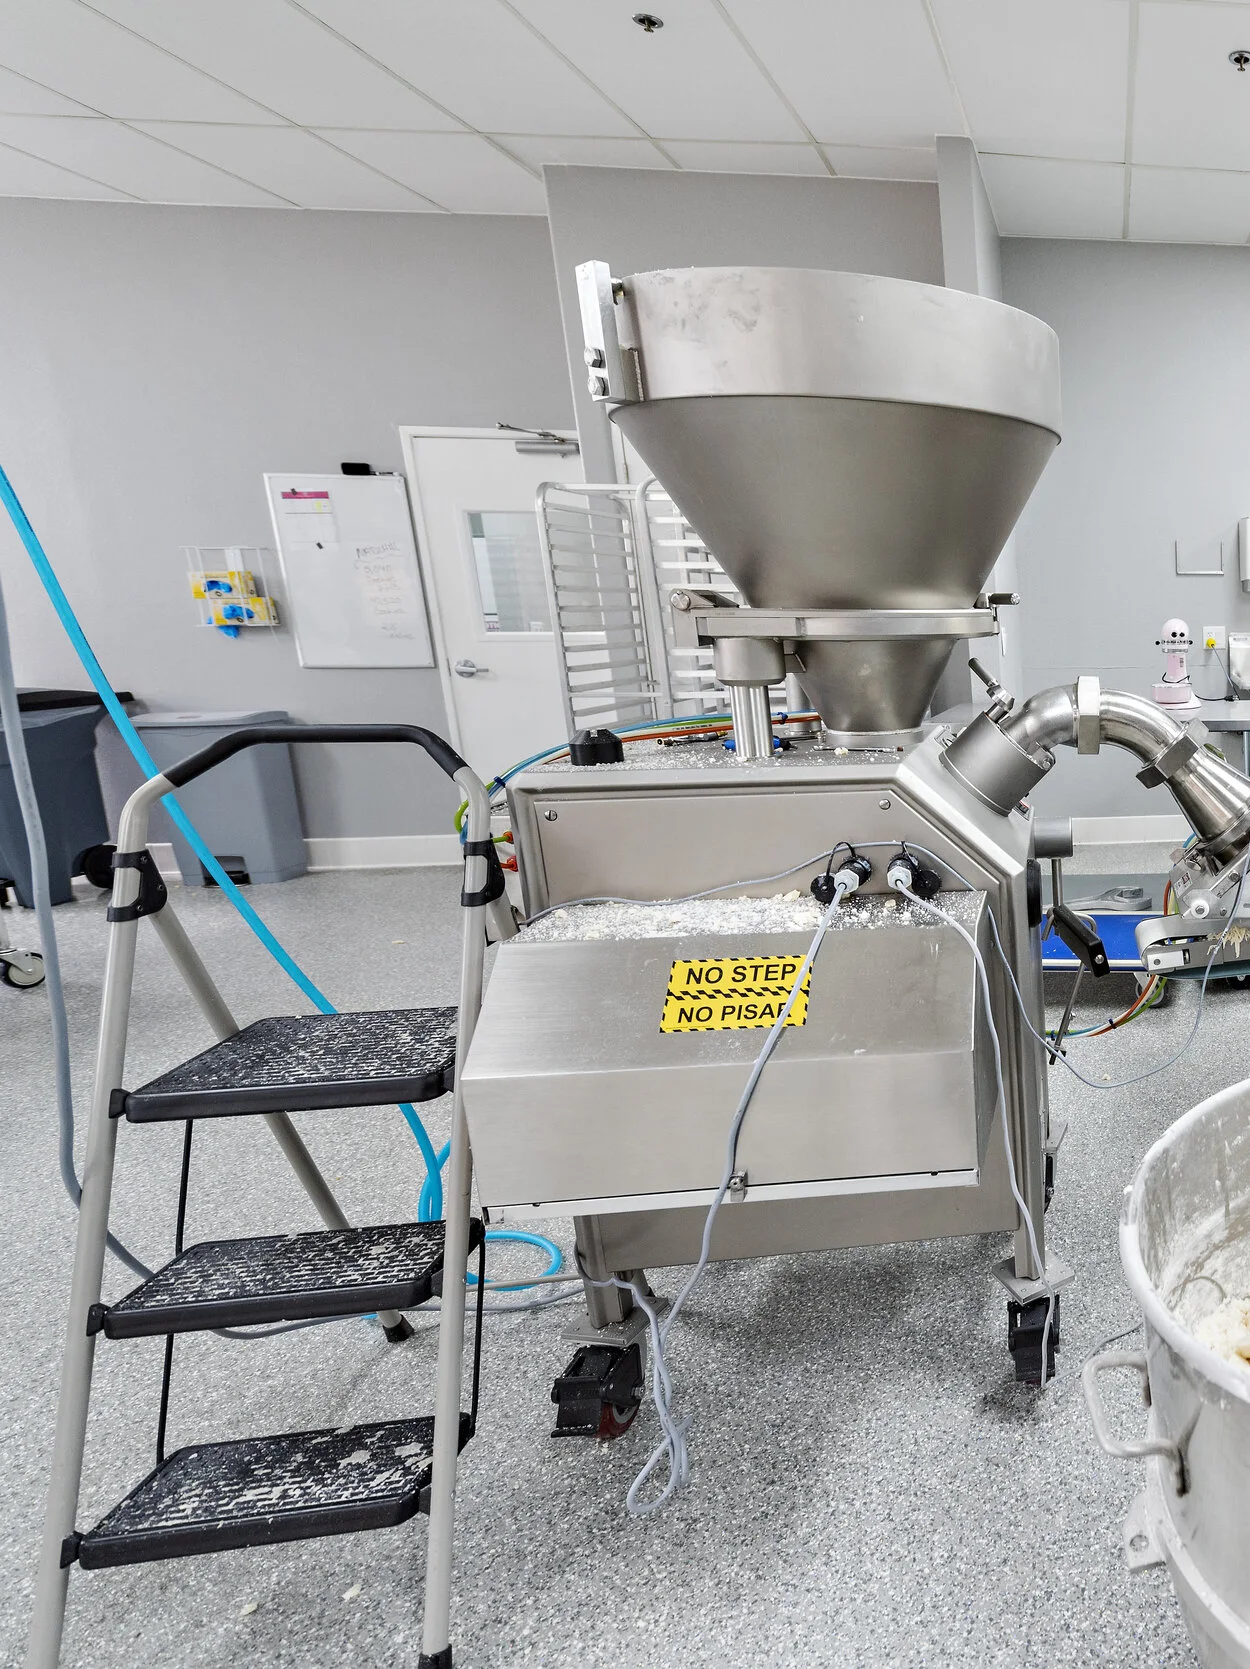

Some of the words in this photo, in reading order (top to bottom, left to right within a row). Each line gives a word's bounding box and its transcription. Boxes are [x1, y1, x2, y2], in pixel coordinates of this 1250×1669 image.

[686, 966, 724, 985] NO
[731, 963, 797, 983] STEP
[678, 1006, 714, 1023] NO
